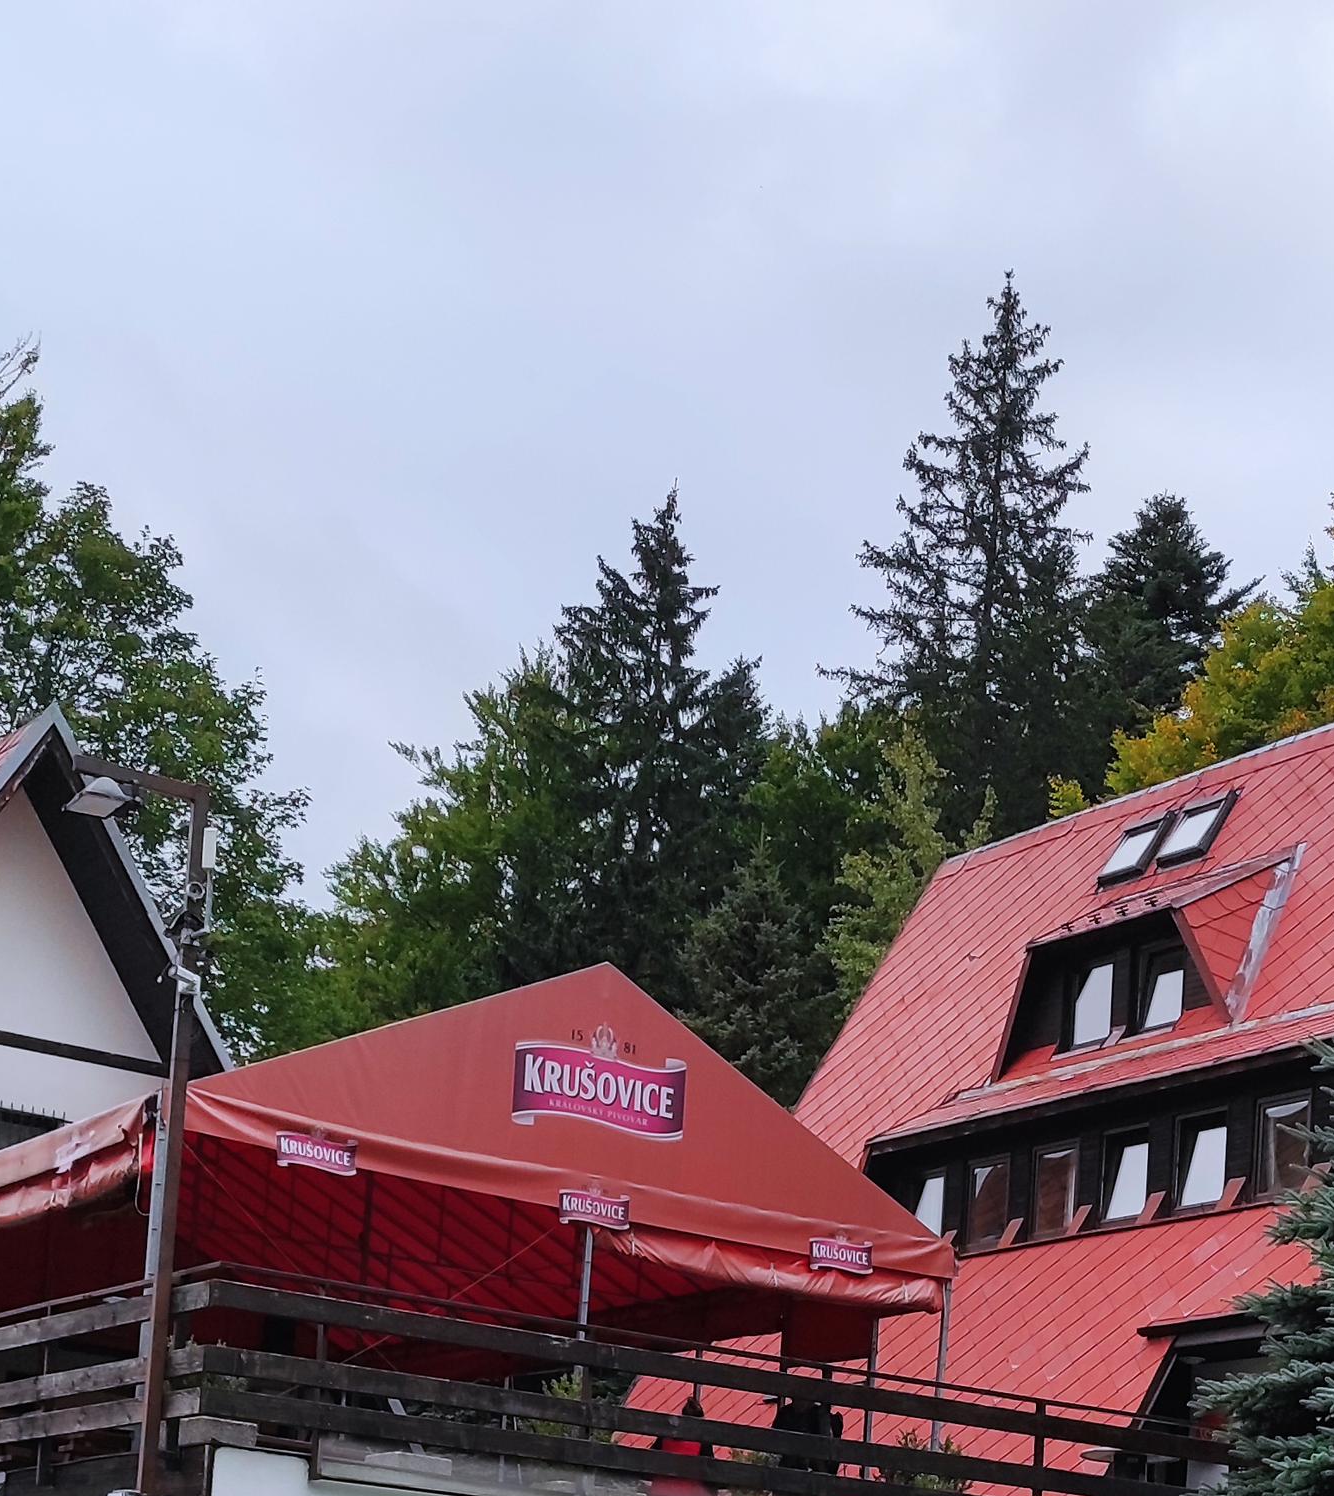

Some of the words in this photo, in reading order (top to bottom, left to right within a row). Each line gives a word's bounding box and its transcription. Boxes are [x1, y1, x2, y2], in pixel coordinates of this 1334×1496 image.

[571, 1029, 584, 1042] 15
[623, 1042, 636, 1055] 81
[524, 1054, 675, 1119] KRUŠOVICE
[607, 1111, 649, 1127] PIVOVAR
[280, 1137, 352, 1166] KRUŠOVICE
[562, 1194, 625, 1221] KRUŠOVICE
[812, 1243, 869, 1266] KRUŠOVICE
